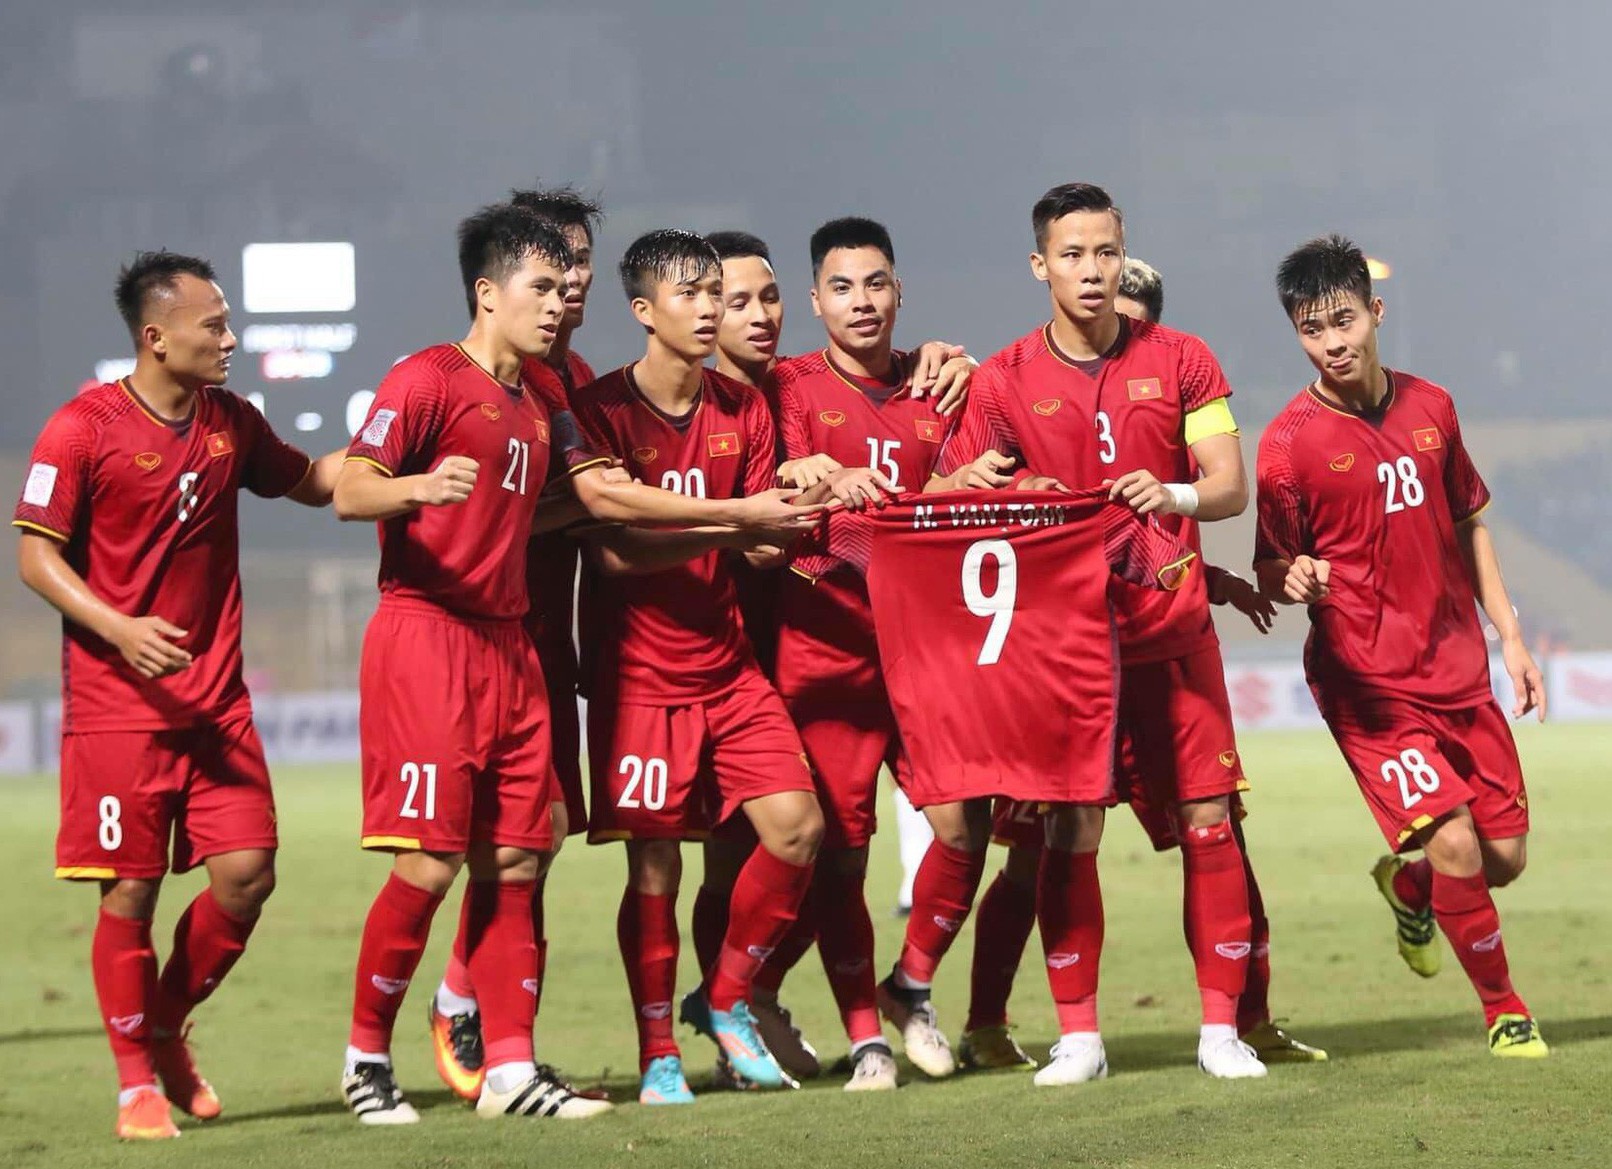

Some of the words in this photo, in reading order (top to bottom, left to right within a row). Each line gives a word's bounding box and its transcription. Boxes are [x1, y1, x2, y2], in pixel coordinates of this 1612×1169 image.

[501, 437, 529, 495] 21
[866, 437, 902, 487] 15
[1094, 411, 1116, 464] 3
[1377, 455, 1425, 514] 28
[961, 539, 1018, 666] 9
[399, 761, 437, 820] 21
[617, 754, 668, 811] 20
[1380, 748, 1440, 810] 28
[98, 795, 123, 851] 8
